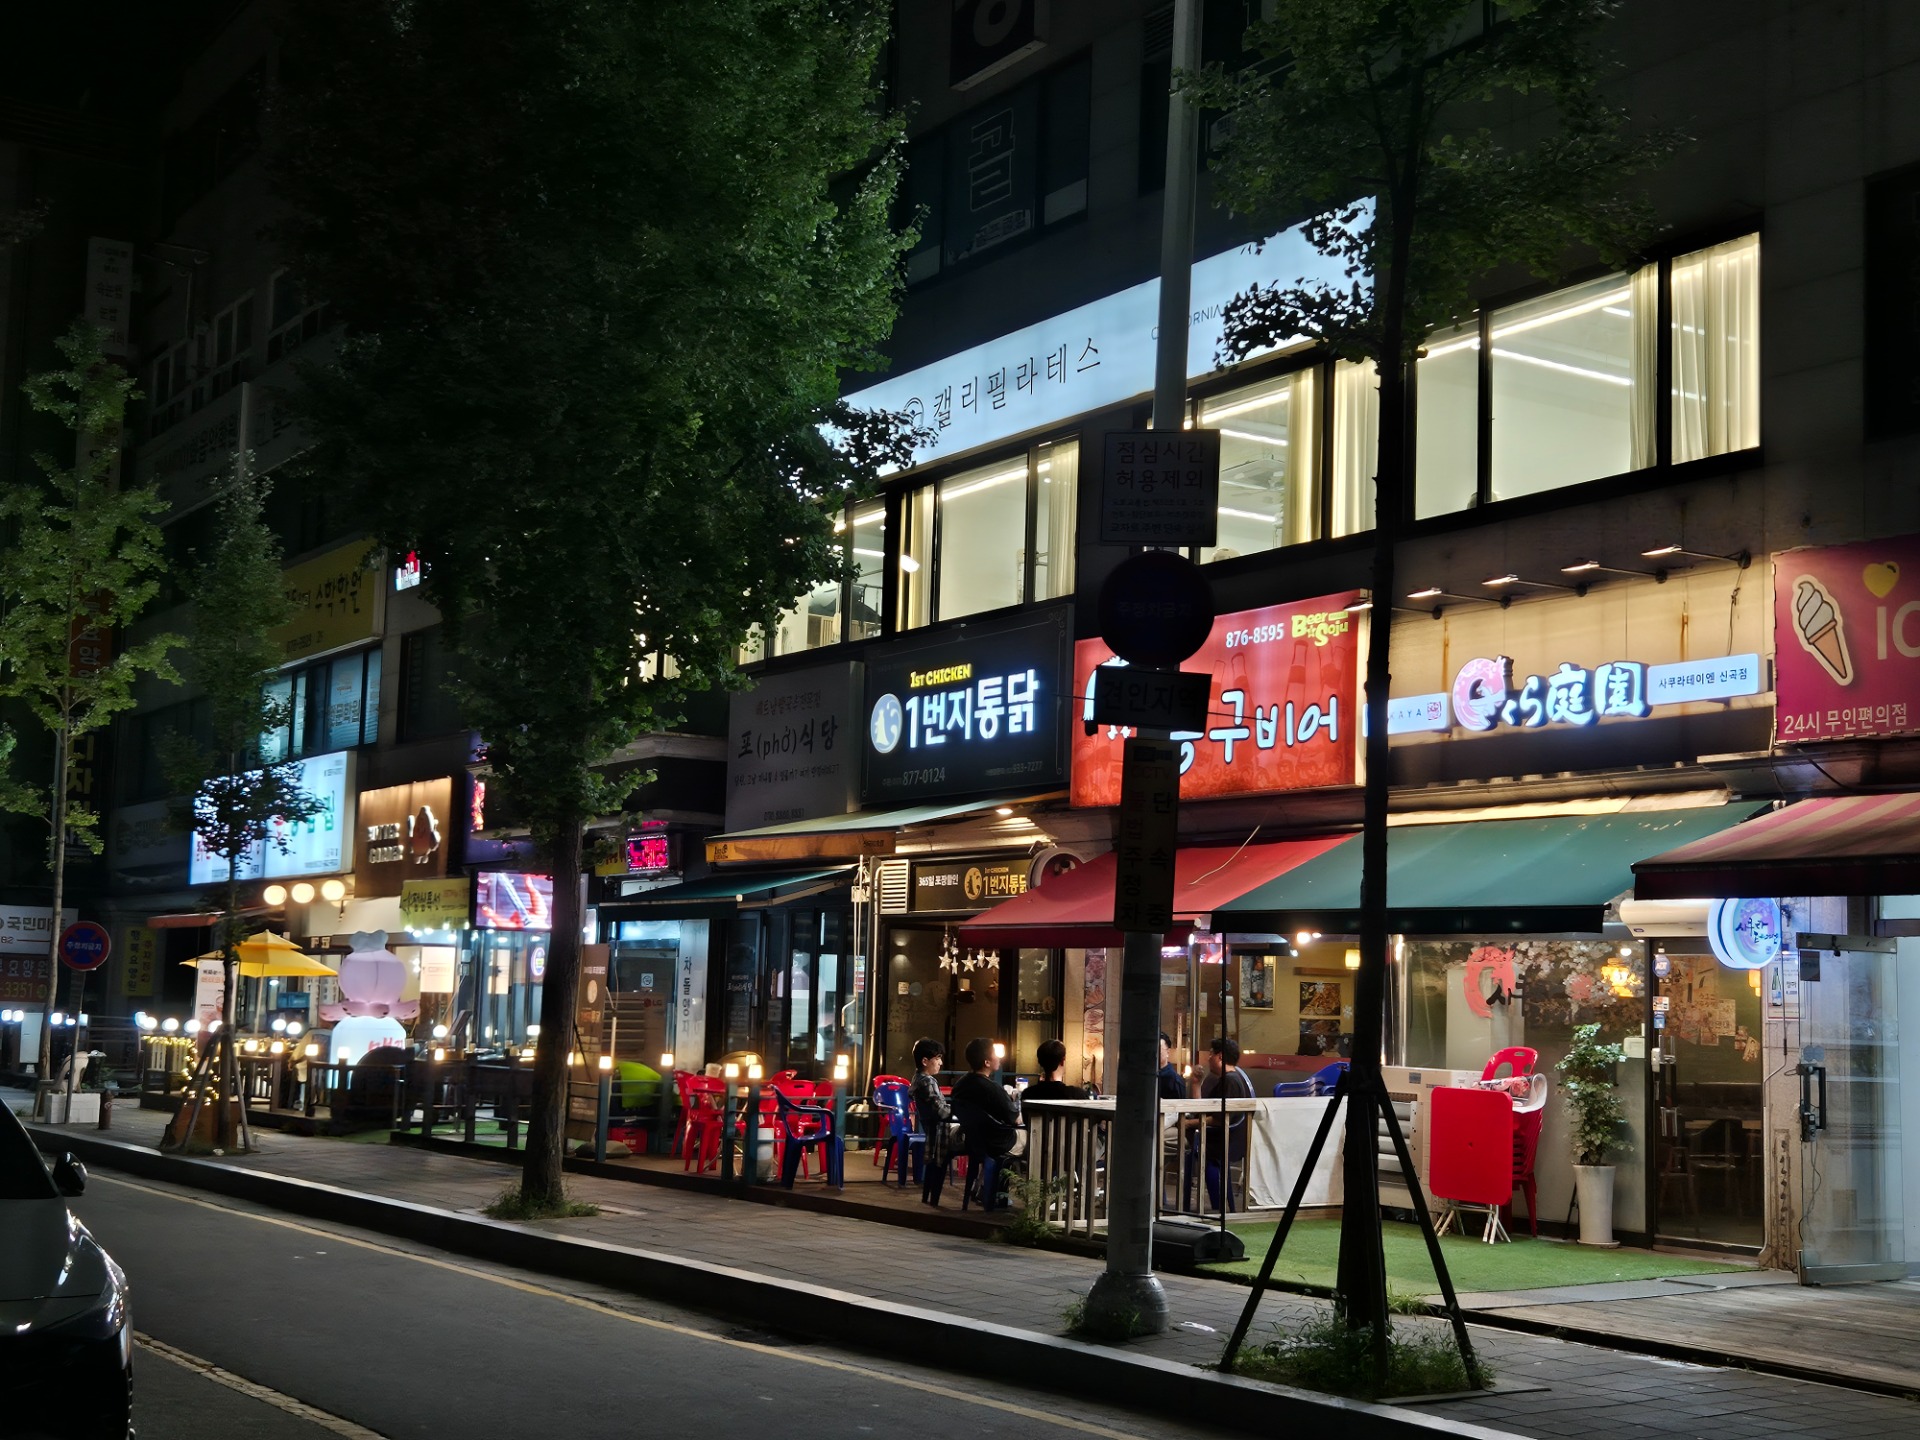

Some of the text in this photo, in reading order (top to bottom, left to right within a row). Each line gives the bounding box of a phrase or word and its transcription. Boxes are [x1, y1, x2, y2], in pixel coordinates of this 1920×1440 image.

[933, 337, 1101, 431] 캘리필라테스
[1117, 440, 1205, 464] 점심시간
[1115, 469, 1203, 493] 허용제외
[1226, 622, 1285, 649] 876-8595
[925, 663, 973, 686] CHICKEN
[1658, 667, 1748, 689] 사쿠라테이엔 신곡점
[905, 668, 1040, 749] 1번지통닭
[1103, 680, 1200, 718] 견인지역
[1783, 702, 1907, 735] 24시 무인편의점
[902, 767, 946, 786] 877-0124
